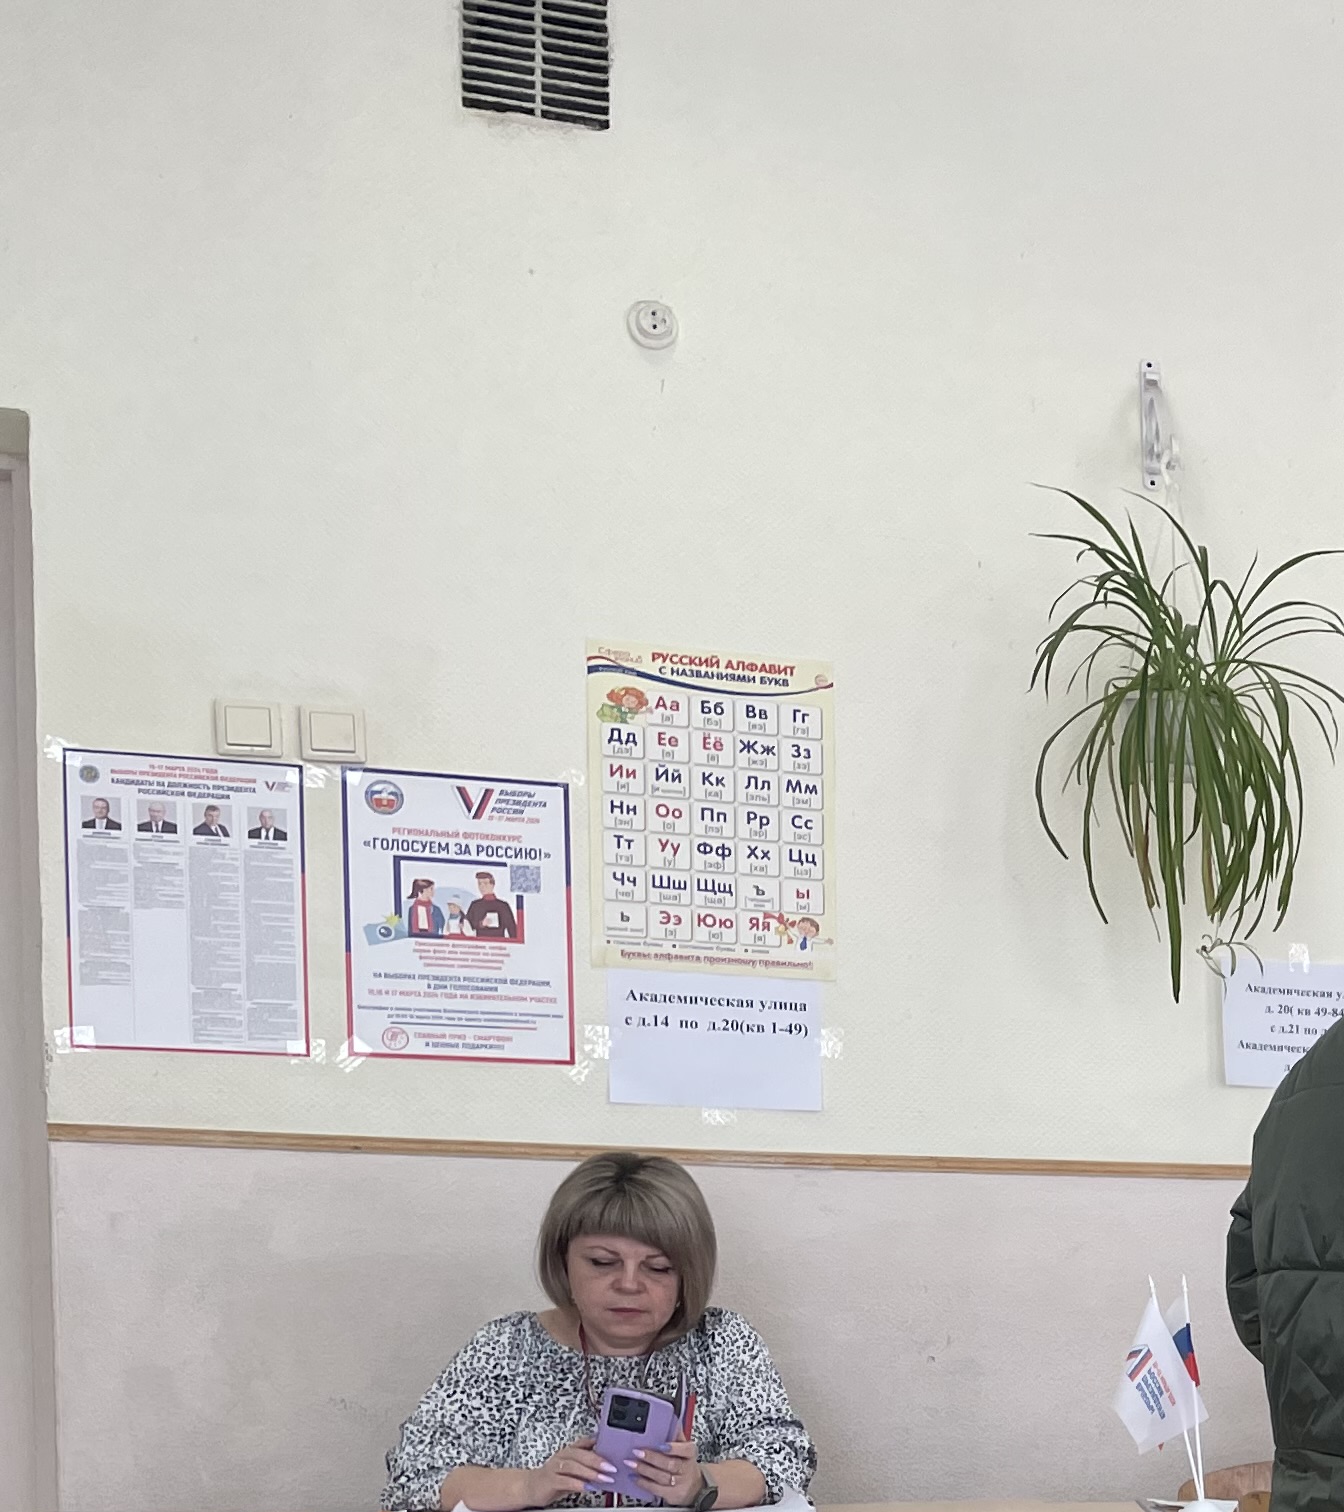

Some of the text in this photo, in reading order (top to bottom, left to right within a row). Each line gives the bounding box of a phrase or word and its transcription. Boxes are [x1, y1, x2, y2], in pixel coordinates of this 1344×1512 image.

[651, 652, 795, 676] РУССКИЙ АЛФАВИТ
[659, 666, 789, 687] С НАЗВАНИЯМИ БУКВ
[655, 696, 679, 711] Аа
[700, 700, 724, 716] Бб
[746, 704, 768, 720] Вв
[792, 709, 809, 724] Гг
[608, 728, 638, 746] Дд
[658, 732, 678, 747] Ее
[702, 732, 724, 751] Ёё
[740, 739, 776, 756] Жж
[791, 744, 811, 759] Зз
[609, 764, 637, 779] Ии
[655, 764, 682, 783] Йй
[702, 772, 726, 787] Кк
[745, 776, 771, 790] Лл
[786, 779, 818, 795] Мм
[610, 800, 637, 816] Нн
[656, 804, 683, 819] Оо
[700, 807, 727, 823] Пп
[747, 812, 770, 829] Рр
[791, 815, 814, 830] Сс
[392, 827, 522, 843] РЕГИОНАЛЬНЫЙ ФОТОКОНКУРС
[614, 835, 634, 850] Тт
[363, 837, 551, 861] «ГОЛОСУЕМ ЗА РОССИЮ!»
[658, 838, 680, 856] Уу
[697, 842, 732, 861] Фф
[747, 845, 771, 861] Хх
[789, 849, 817, 866] Цц
[613, 872, 637, 886] Чч
[652, 874, 687, 891] Шш
[697, 878, 733, 896] Щщ
[659, 911, 682, 925] Ээ
[697, 914, 734, 929] Юю
[749, 917, 771, 931] Яя
[1246, 984, 1333, 999] Академическая
[626, 989, 807, 1012] Академическая улица
[624, 1016, 632, 1026] с
[637, 1015, 669, 1028] д.14
[680, 1018, 698, 1030] по
[771, 1022, 808, 1038] 1-49)
[1304, 1026, 1318, 1036] по
[1238, 1040, 1311, 1054] Академическ
